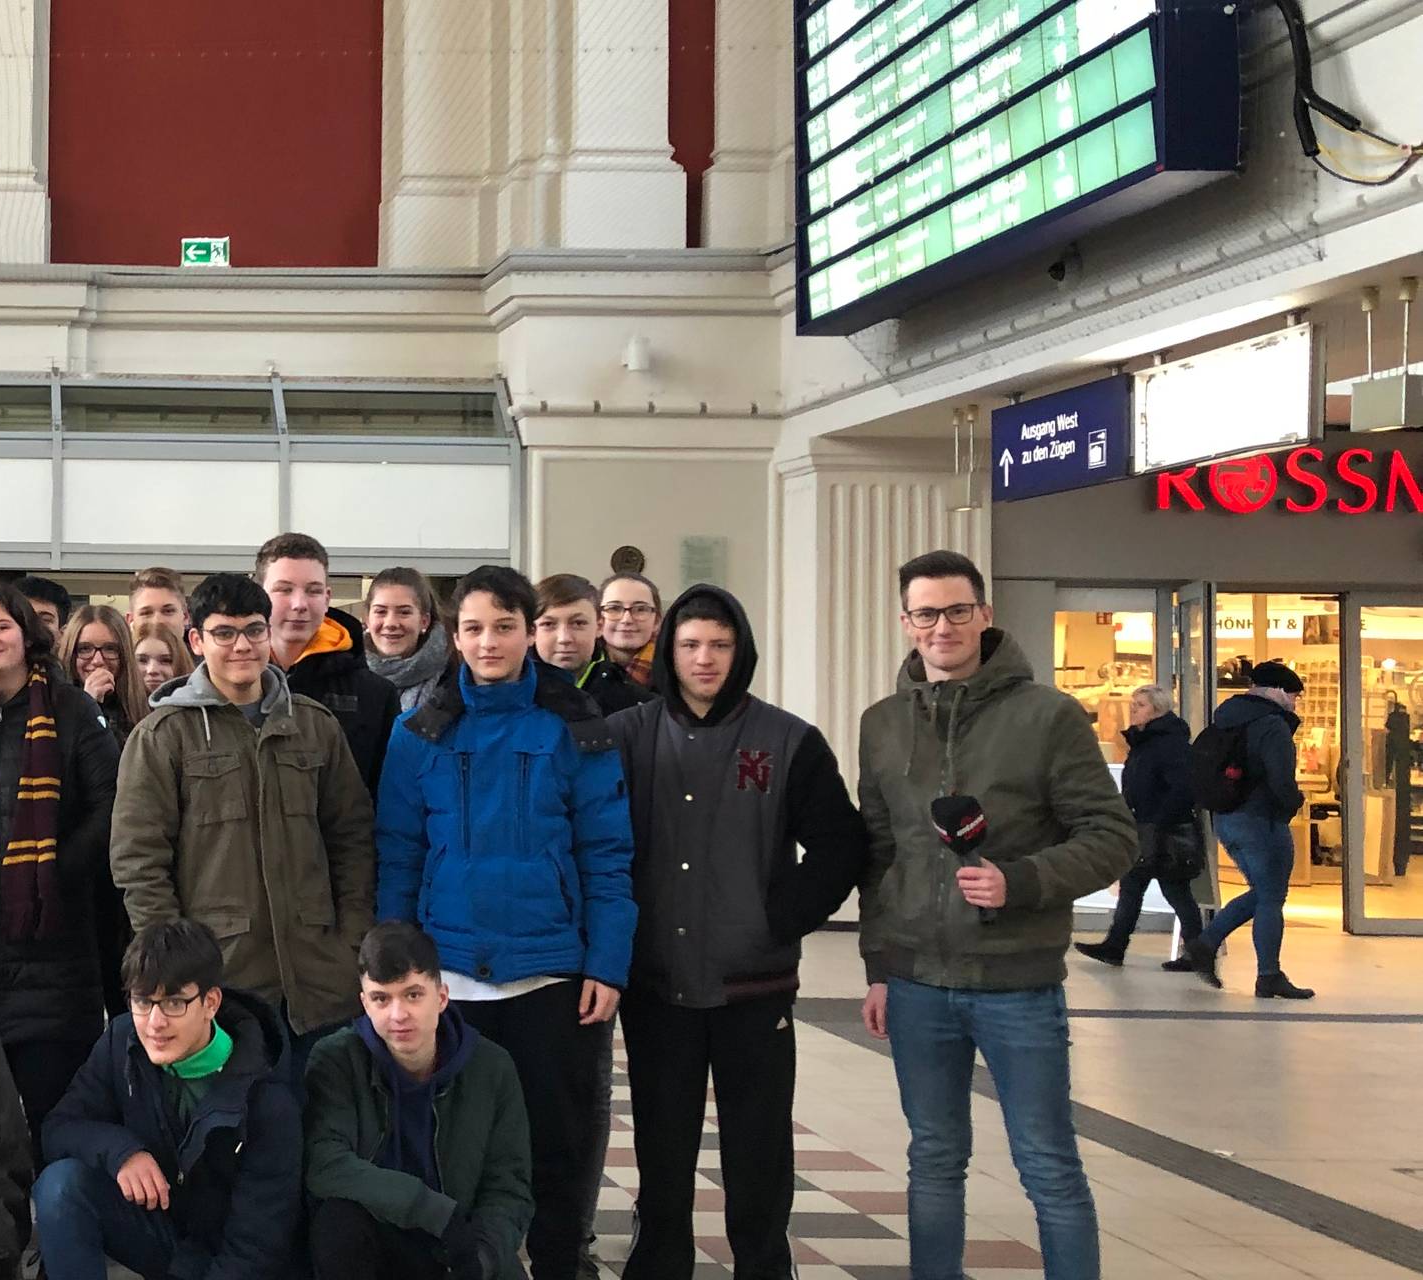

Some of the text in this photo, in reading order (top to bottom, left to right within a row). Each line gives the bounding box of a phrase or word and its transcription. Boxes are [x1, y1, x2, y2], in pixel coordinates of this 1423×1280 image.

[1021, 411, 1079, 441] Ausgang West
[1022, 440, 1076, 465] zu den Zügen
[1287, 618, 1297, 630] &
